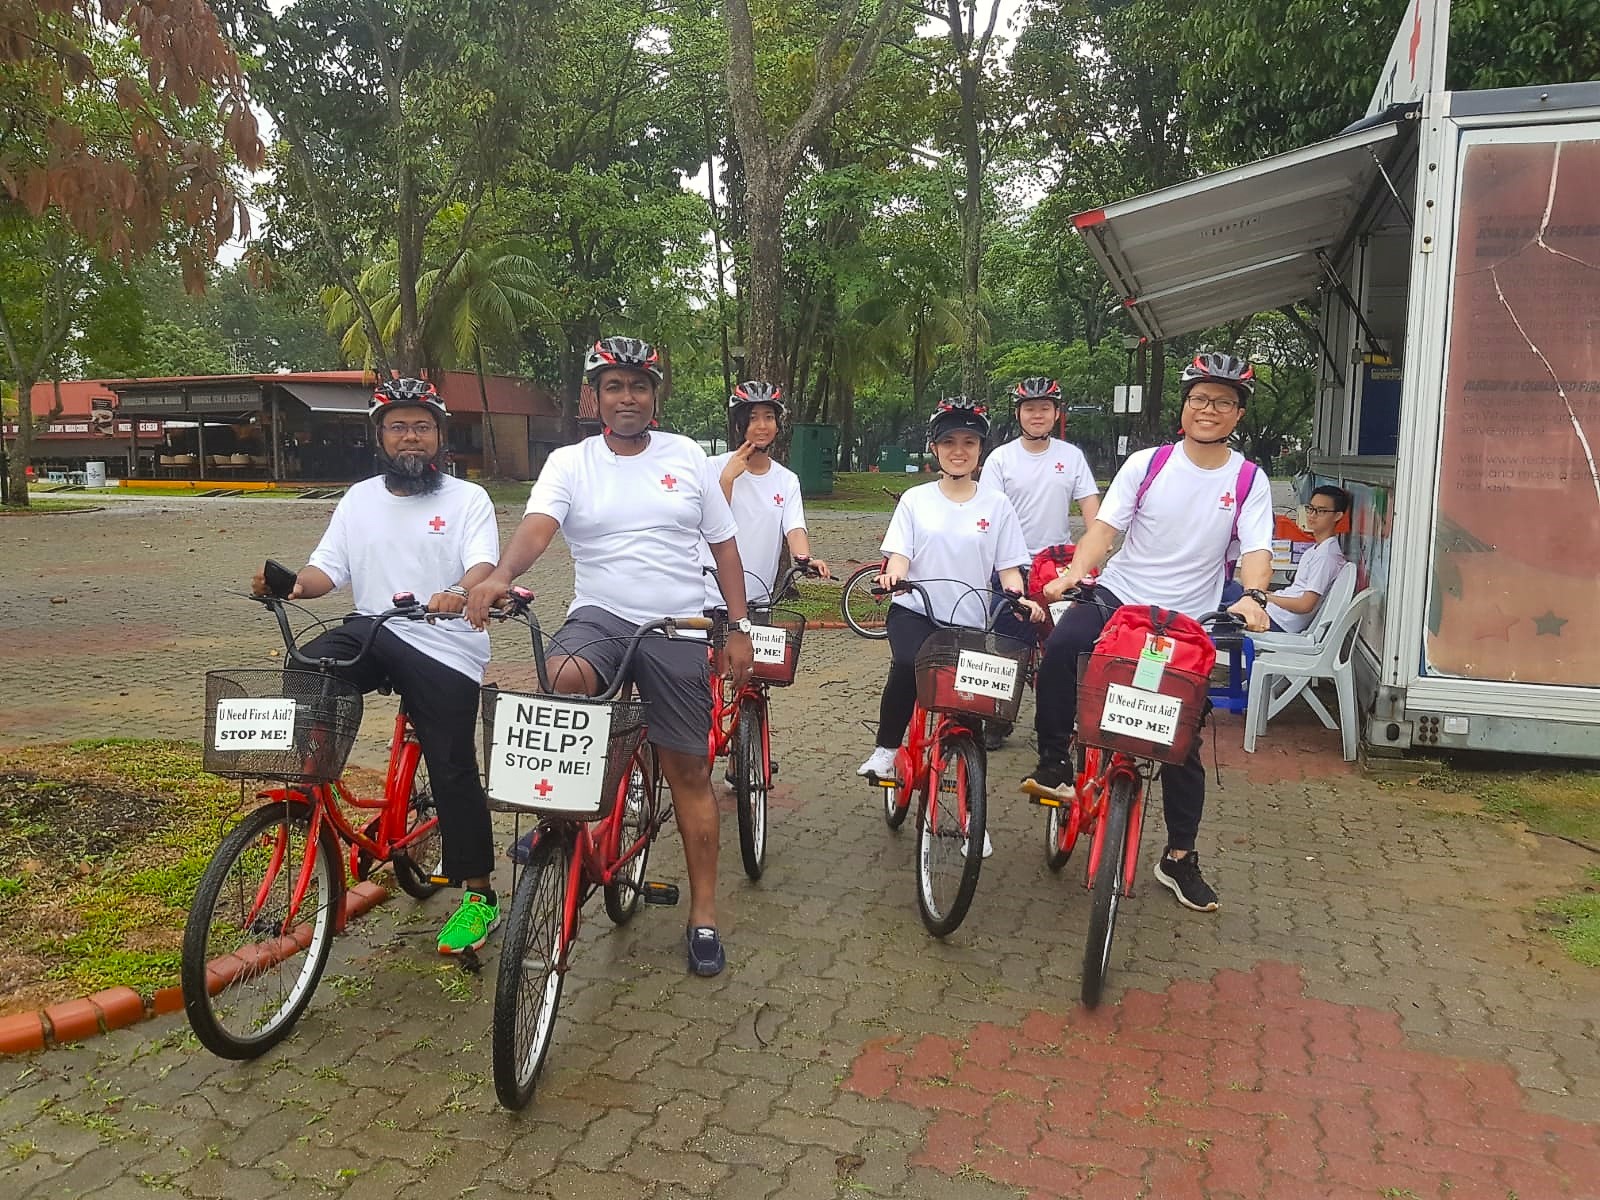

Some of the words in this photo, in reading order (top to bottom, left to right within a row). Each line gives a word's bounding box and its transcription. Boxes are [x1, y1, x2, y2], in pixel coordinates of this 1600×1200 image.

[756, 632, 770, 643] First
[771, 634, 784, 644] Aid?
[763, 648, 781, 657] ME!
[960, 658, 966, 667] U
[967, 658, 984, 671] Need
[984, 662, 1000, 675] First
[1000, 666, 1015, 678] Aid?
[960, 675, 989, 687] STOP
[991, 681, 1010, 692] ME!
[219, 709, 226, 721] U
[226, 708, 247, 721] Need
[249, 708, 270, 721] First
[271, 708, 293, 721] Aid?
[1109, 693, 1115, 704] U
[1116, 694, 1137, 709] Need
[1137, 699, 1157, 713] First
[1157, 704, 1177, 718] Aid?
[516, 703, 590, 730] NEED
[1107, 713, 1143, 728] STOP
[1145, 721, 1170, 735] ME!
[220, 730, 257, 740] STOP
[260, 730, 287, 740] ME!
[507, 726, 594, 755] HELP?
[505, 753, 553, 772] STOP
[558, 760, 591, 775] ME!
